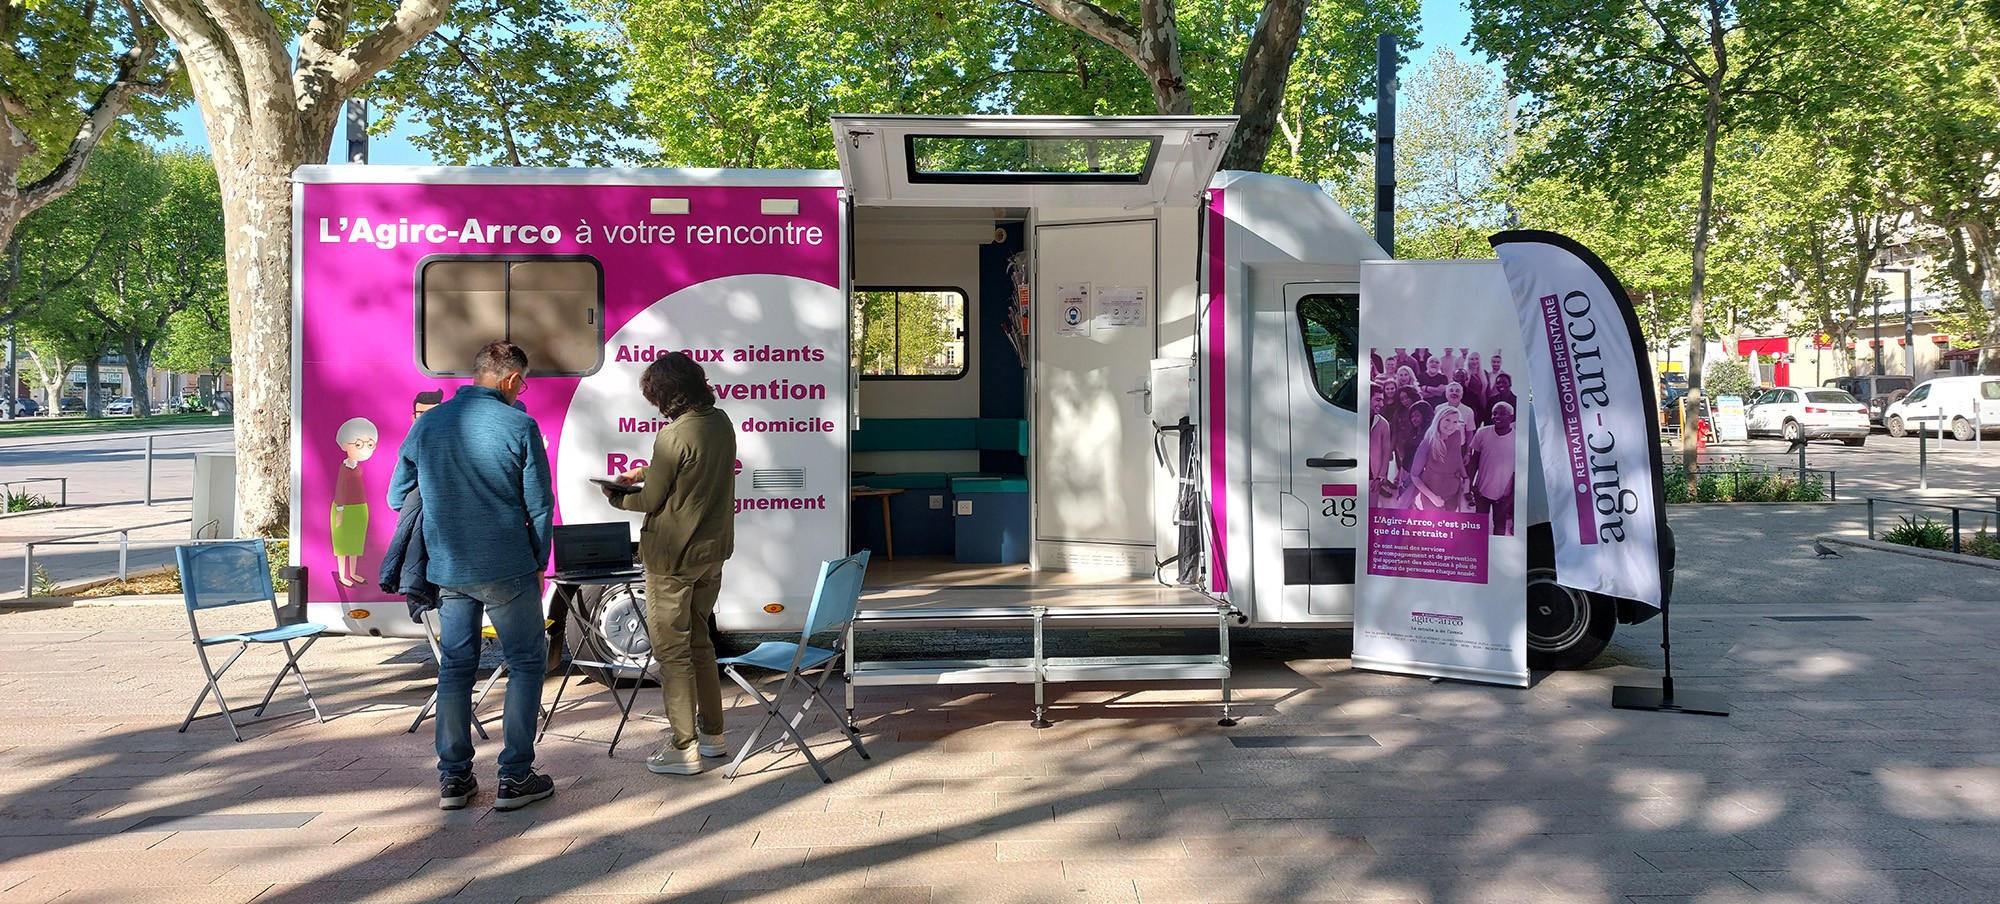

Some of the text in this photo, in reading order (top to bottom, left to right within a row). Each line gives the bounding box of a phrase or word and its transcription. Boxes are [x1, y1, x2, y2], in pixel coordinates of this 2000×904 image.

[319, 217, 823, 250] L’Agirc-Arrco à votre rencontre
[733, 345, 825, 362] aidants
[714, 379, 826, 400] vention
[1546, 298, 1586, 477] RETRAITE COMPLEMENTAIRE
[741, 417, 834, 432] domicile
[1374, 516, 1481, 530] L’Agirc-Arrco, c’est plus
[1402, 528, 1410, 536] la
[1412, 530, 1448, 538] retraite
[1450, 531, 1454, 539] !
